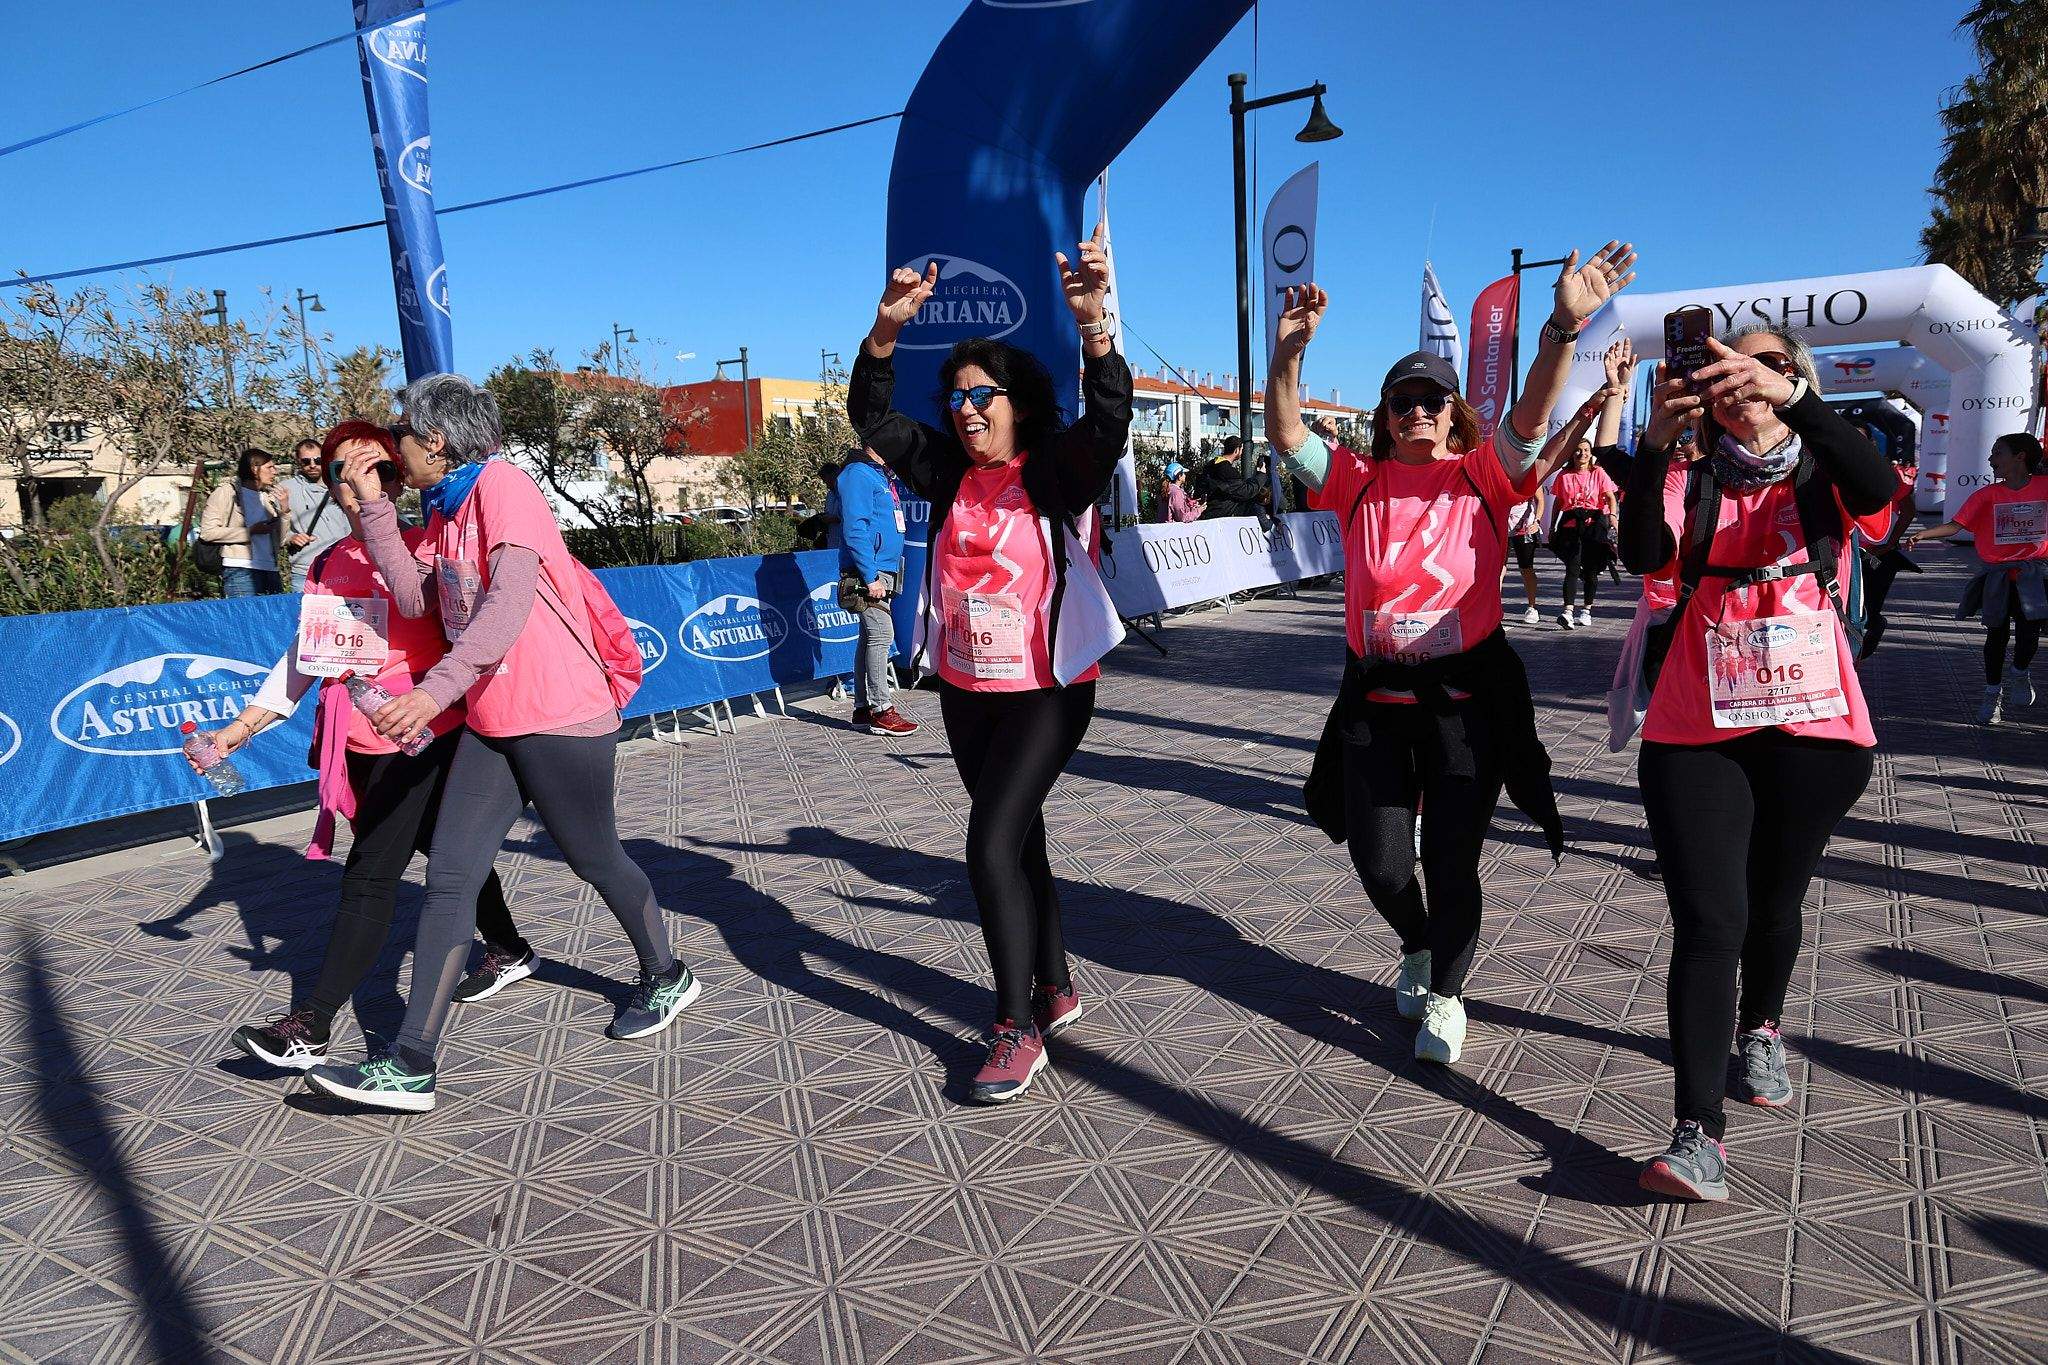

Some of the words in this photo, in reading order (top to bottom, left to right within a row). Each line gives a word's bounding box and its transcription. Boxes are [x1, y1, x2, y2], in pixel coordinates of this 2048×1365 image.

[945, 285, 1007, 296] LECHERA
[1674, 289, 1868, 332] YSHO
[1929, 318, 1995, 335] OYSHO
[1481, 304, 1504, 395] Santander
[1962, 395, 2024, 411] OYSHO
[1142, 534, 1212, 574] OYSHO
[334, 633, 364, 648] 016
[692, 620, 784, 651] ASTURIANA
[963, 629, 993, 646] 016
[307, 664, 341, 674] OYSHO
[1755, 663, 1805, 685] 016
[109, 686, 192, 705] CENTRAL
[1767, 686, 1791, 697] 2717
[1728, 710, 1770, 722] OYSHO
